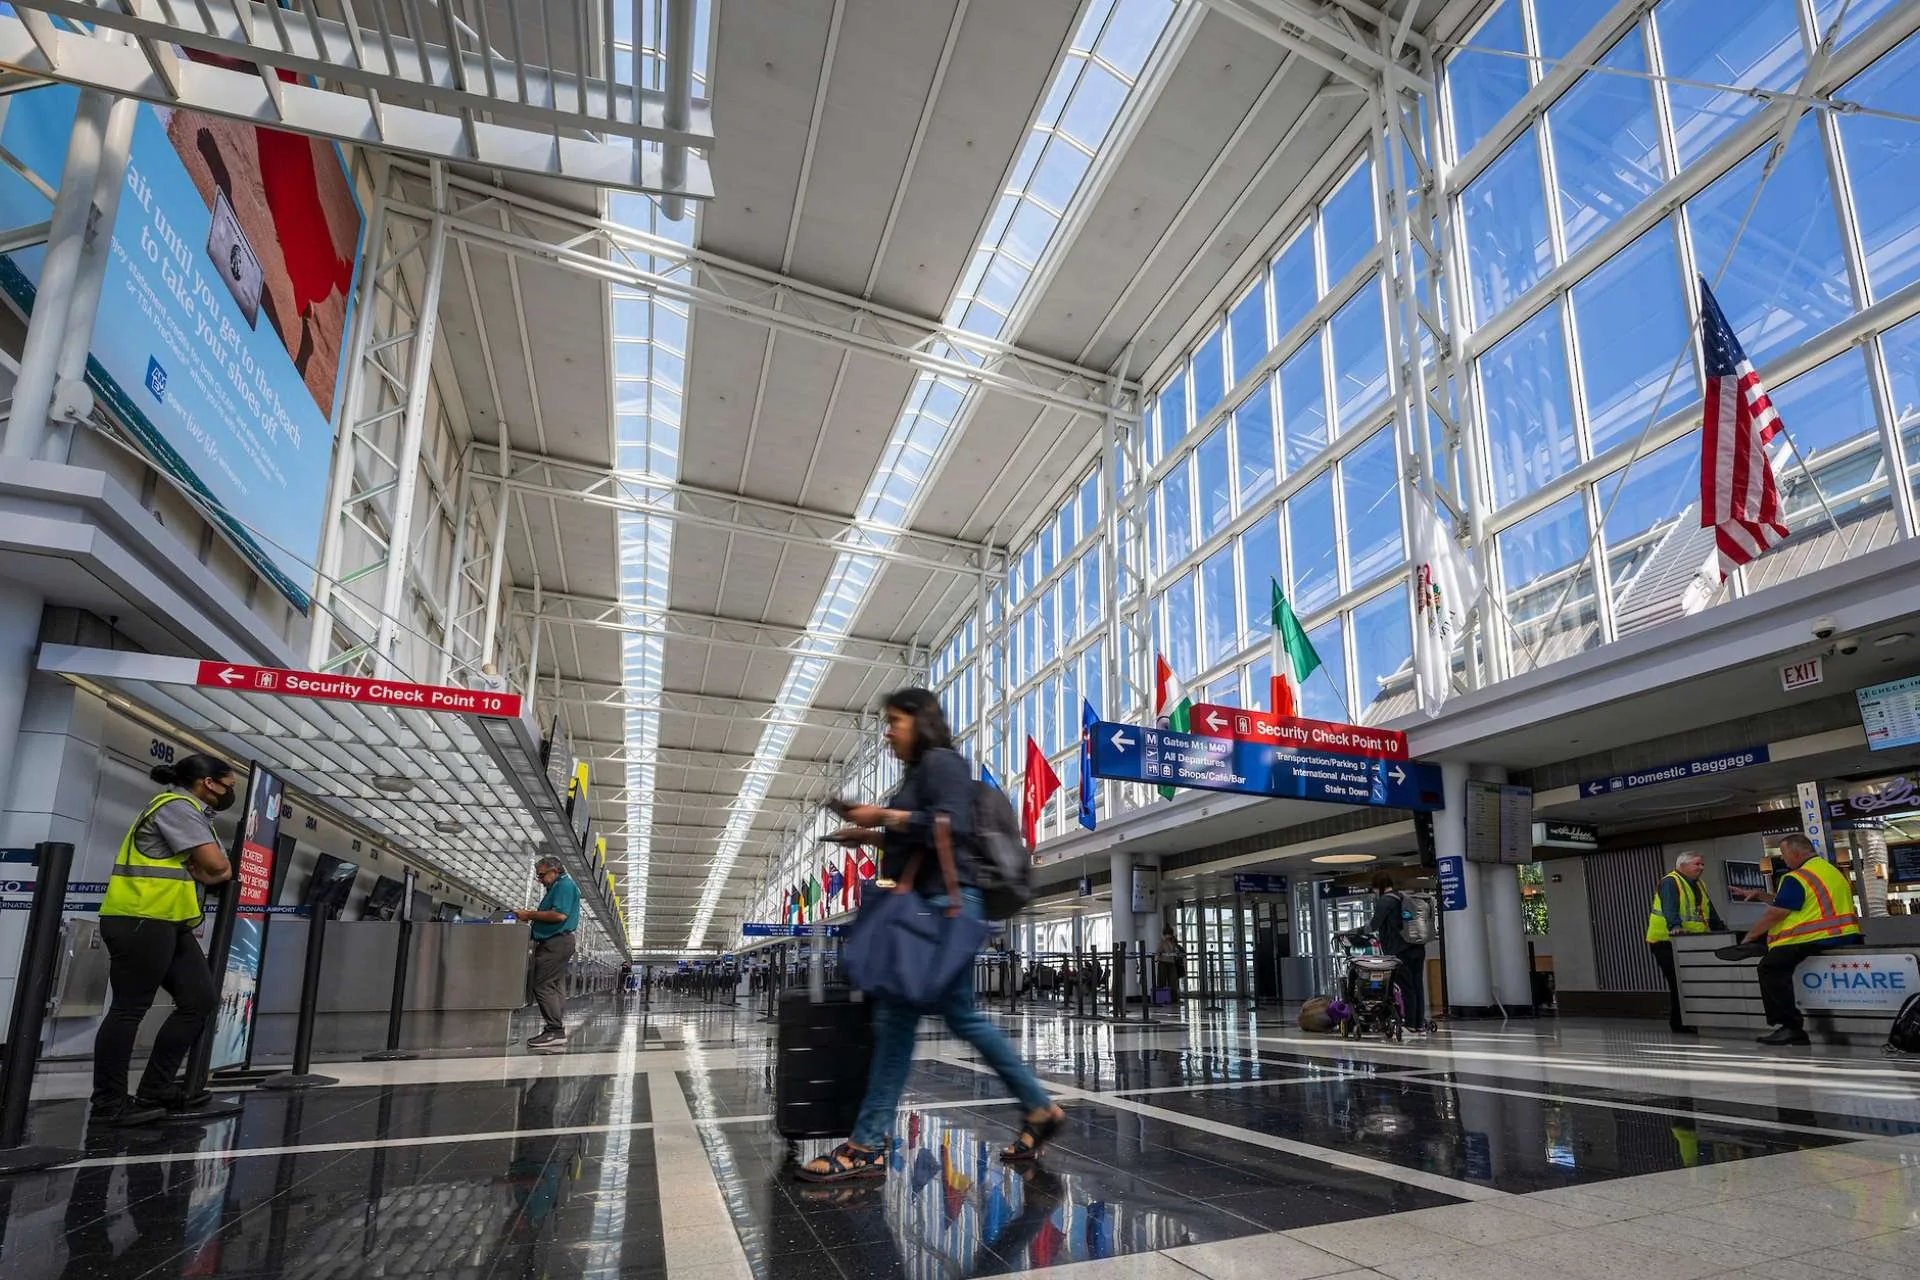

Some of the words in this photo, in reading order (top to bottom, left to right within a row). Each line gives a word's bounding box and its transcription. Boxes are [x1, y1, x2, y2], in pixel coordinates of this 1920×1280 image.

[111, 235, 128, 263] njoy
[128, 153, 152, 213] ait
[154, 205, 193, 278] until
[192, 270, 219, 322] you
[219, 316, 242, 354] get
[242, 346, 254, 374] to
[255, 367, 273, 405] the
[273, 394, 301, 450] beach
[138, 292, 152, 319] TSA
[141, 225, 158, 263] to
[162, 256, 194, 319] take
[195, 311, 228, 367] your
[227, 361, 260, 418] shoes
[1783, 660, 1817, 685] EXIT
[285, 675, 361, 699] Security
[369, 685, 425, 703] Check
[432, 692, 475, 708] Point
[482, 698, 501, 711] 10
[1163, 736, 1189, 748] Gates
[1257, 720, 1309, 744] Security
[1312, 729, 1349, 746] Check
[1352, 735, 1382, 751] Point
[1385, 739, 1398, 752] 10
[150, 738, 174, 764] 39B
[1163, 753, 1176, 762] All
[1178, 754, 1226, 768] Departures
[1276, 751, 1358, 771] Transportation/Parking
[1360, 762, 1366, 770] D
[1292, 767, 1338, 780] International
[1340, 773, 1368, 783] Arrivals
[1628, 767, 1687, 787] Domestic
[1691, 753, 1754, 774] Baggage
[1325, 784, 1346, 795] Stairs
[1349, 787, 1369, 797] Down
[240, 860, 269, 877] PASSENGERS
[238, 873, 252, 885] ONLY
[251, 876, 270, 889] BEYOND
[247, 887, 262, 899] POINT
[1802, 972, 1906, 989] O'HARE
